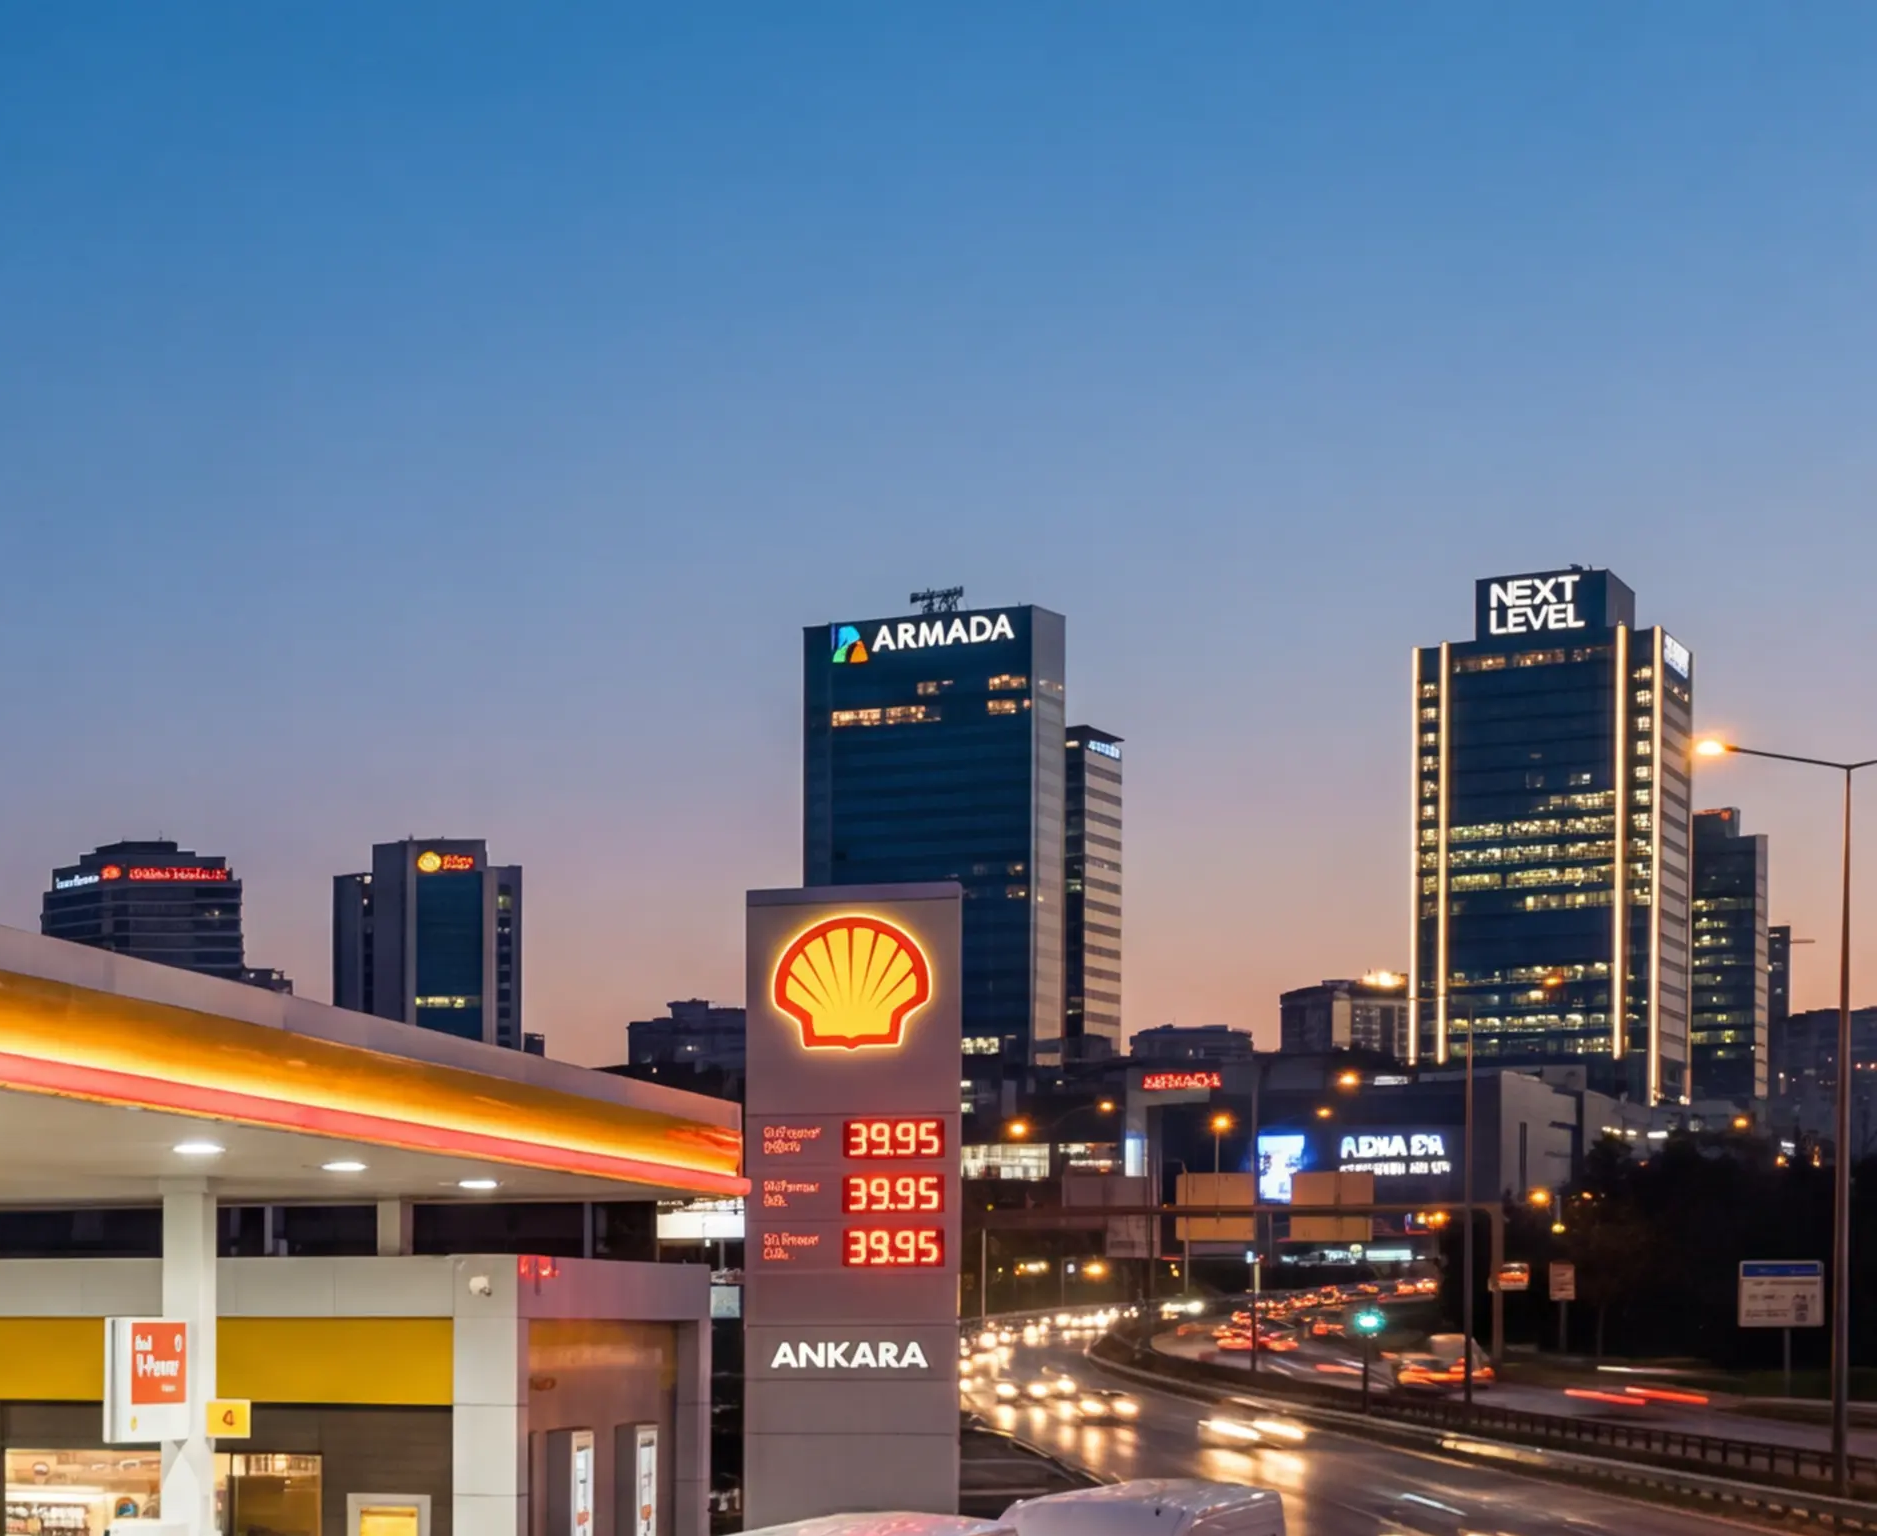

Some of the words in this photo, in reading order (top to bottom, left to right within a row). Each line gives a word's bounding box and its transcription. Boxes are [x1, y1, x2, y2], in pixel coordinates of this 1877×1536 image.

[1489, 575, 1580, 608] NEXT
[871, 613, 1015, 652] ARMADA
[1489, 603, 1585, 635] LEVEL
[849, 1122, 939, 1156] 39.95
[849, 1177, 939, 1211] 39.95
[771, 1342, 928, 1369] ANKARA
